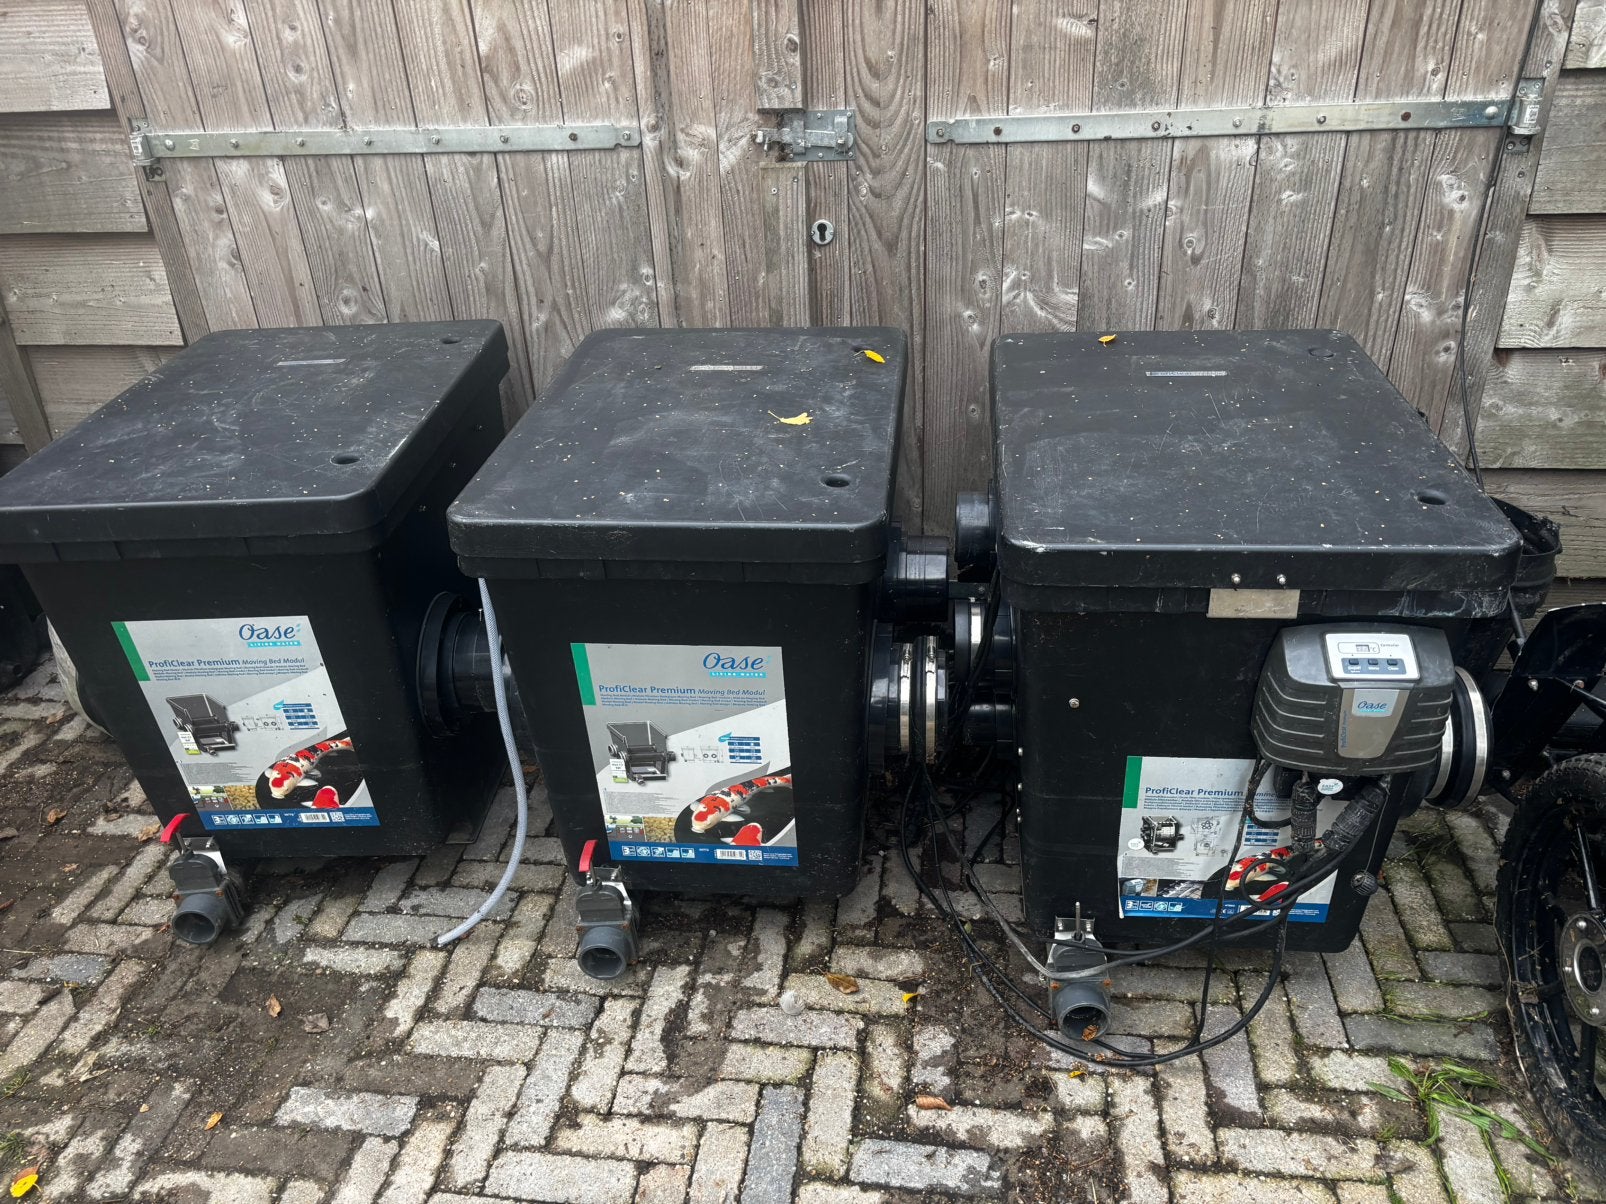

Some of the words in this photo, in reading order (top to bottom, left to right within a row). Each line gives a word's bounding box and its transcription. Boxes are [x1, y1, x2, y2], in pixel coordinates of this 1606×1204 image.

[238, 623, 296, 641] Oase
[148, 659, 195, 668] ProfiClear
[197, 658, 240, 667] Premium
[702, 652, 764, 671] Oase
[598, 684, 648, 693] ProfiClear
[650, 686, 696, 695] Premium
[697, 688, 725, 696] Moving
[1357, 700, 1388, 710] Oase
[1145, 786, 1195, 795] ProfiClear
[1197, 788, 1244, 797] Premium
